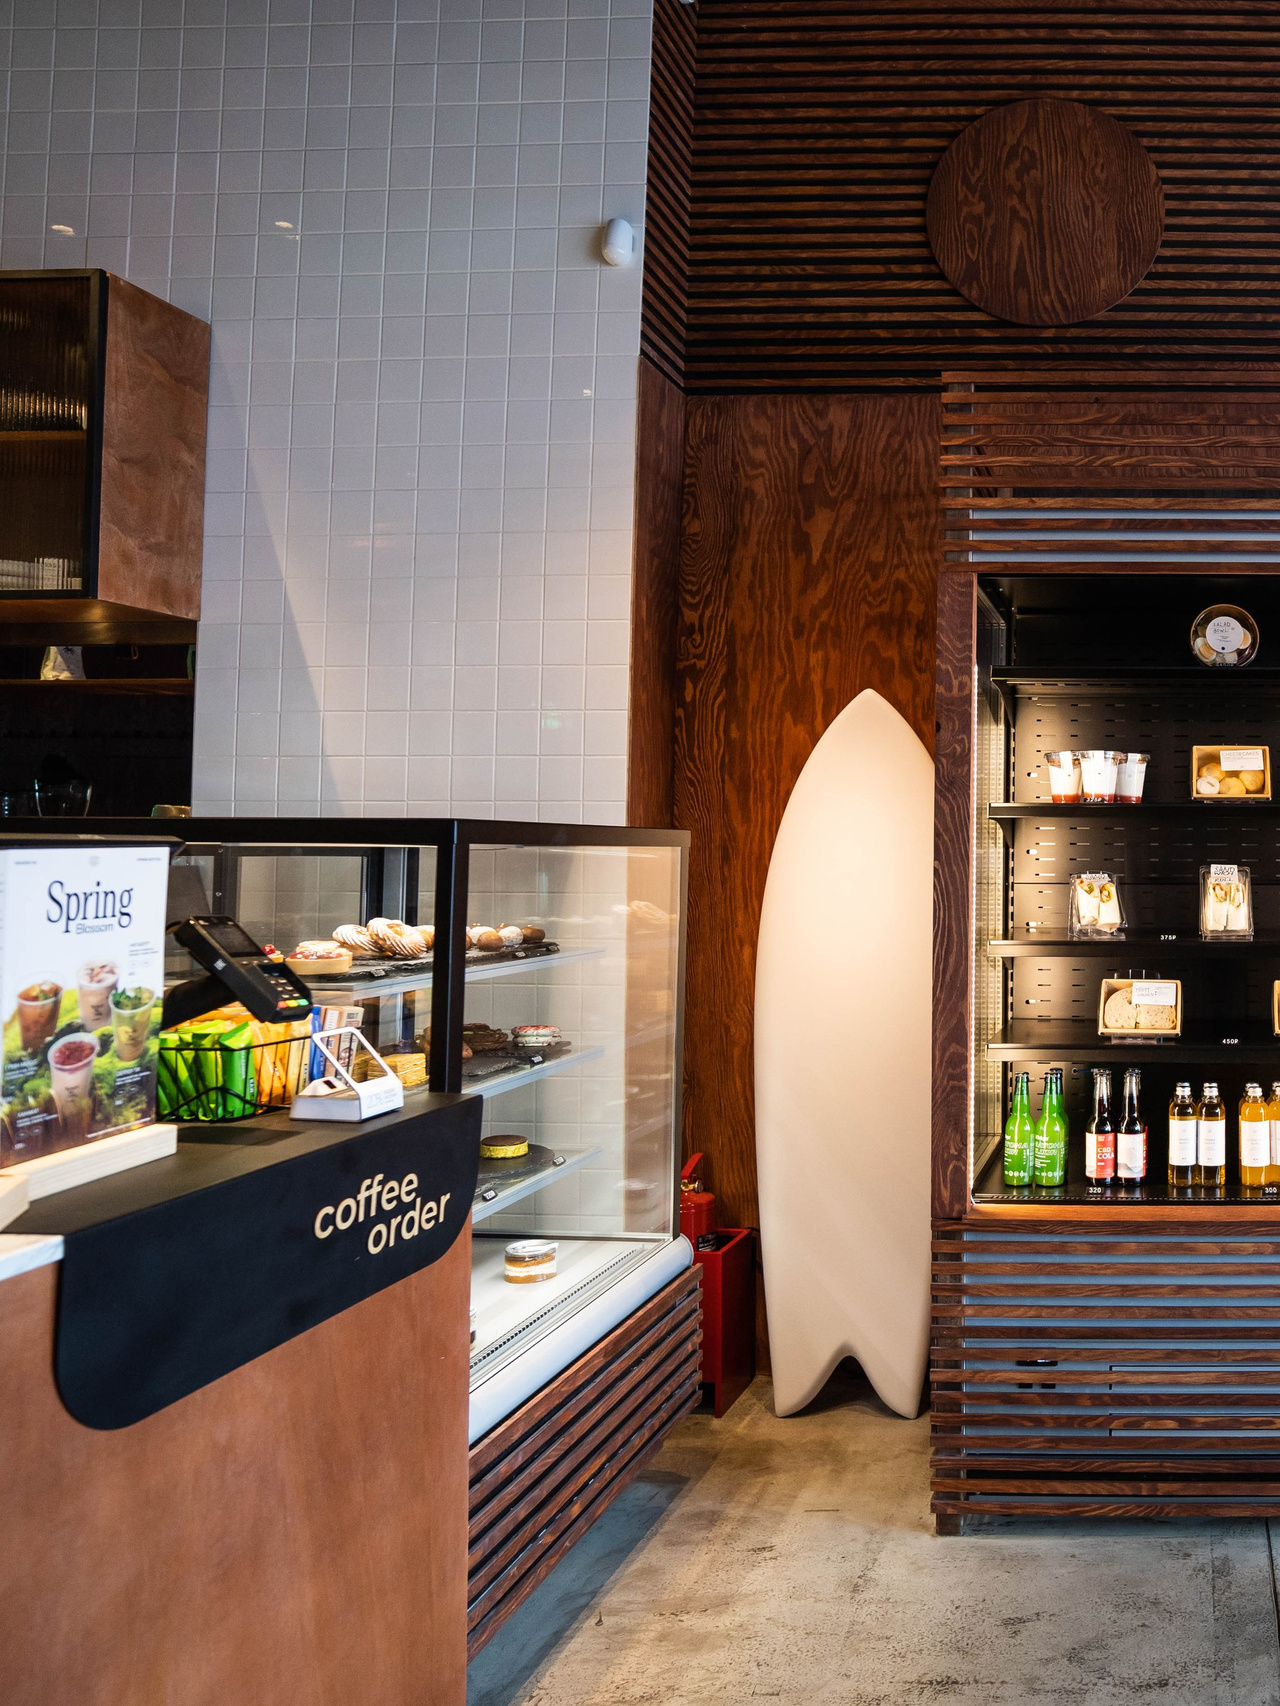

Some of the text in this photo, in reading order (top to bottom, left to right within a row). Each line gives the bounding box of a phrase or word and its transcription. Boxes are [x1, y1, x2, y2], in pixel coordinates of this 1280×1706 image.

[46, 880, 133, 934] Spring
[75, 923, 114, 934] Blossom
[314, 1173, 418, 1239] coffee
[367, 1192, 451, 1255] order
